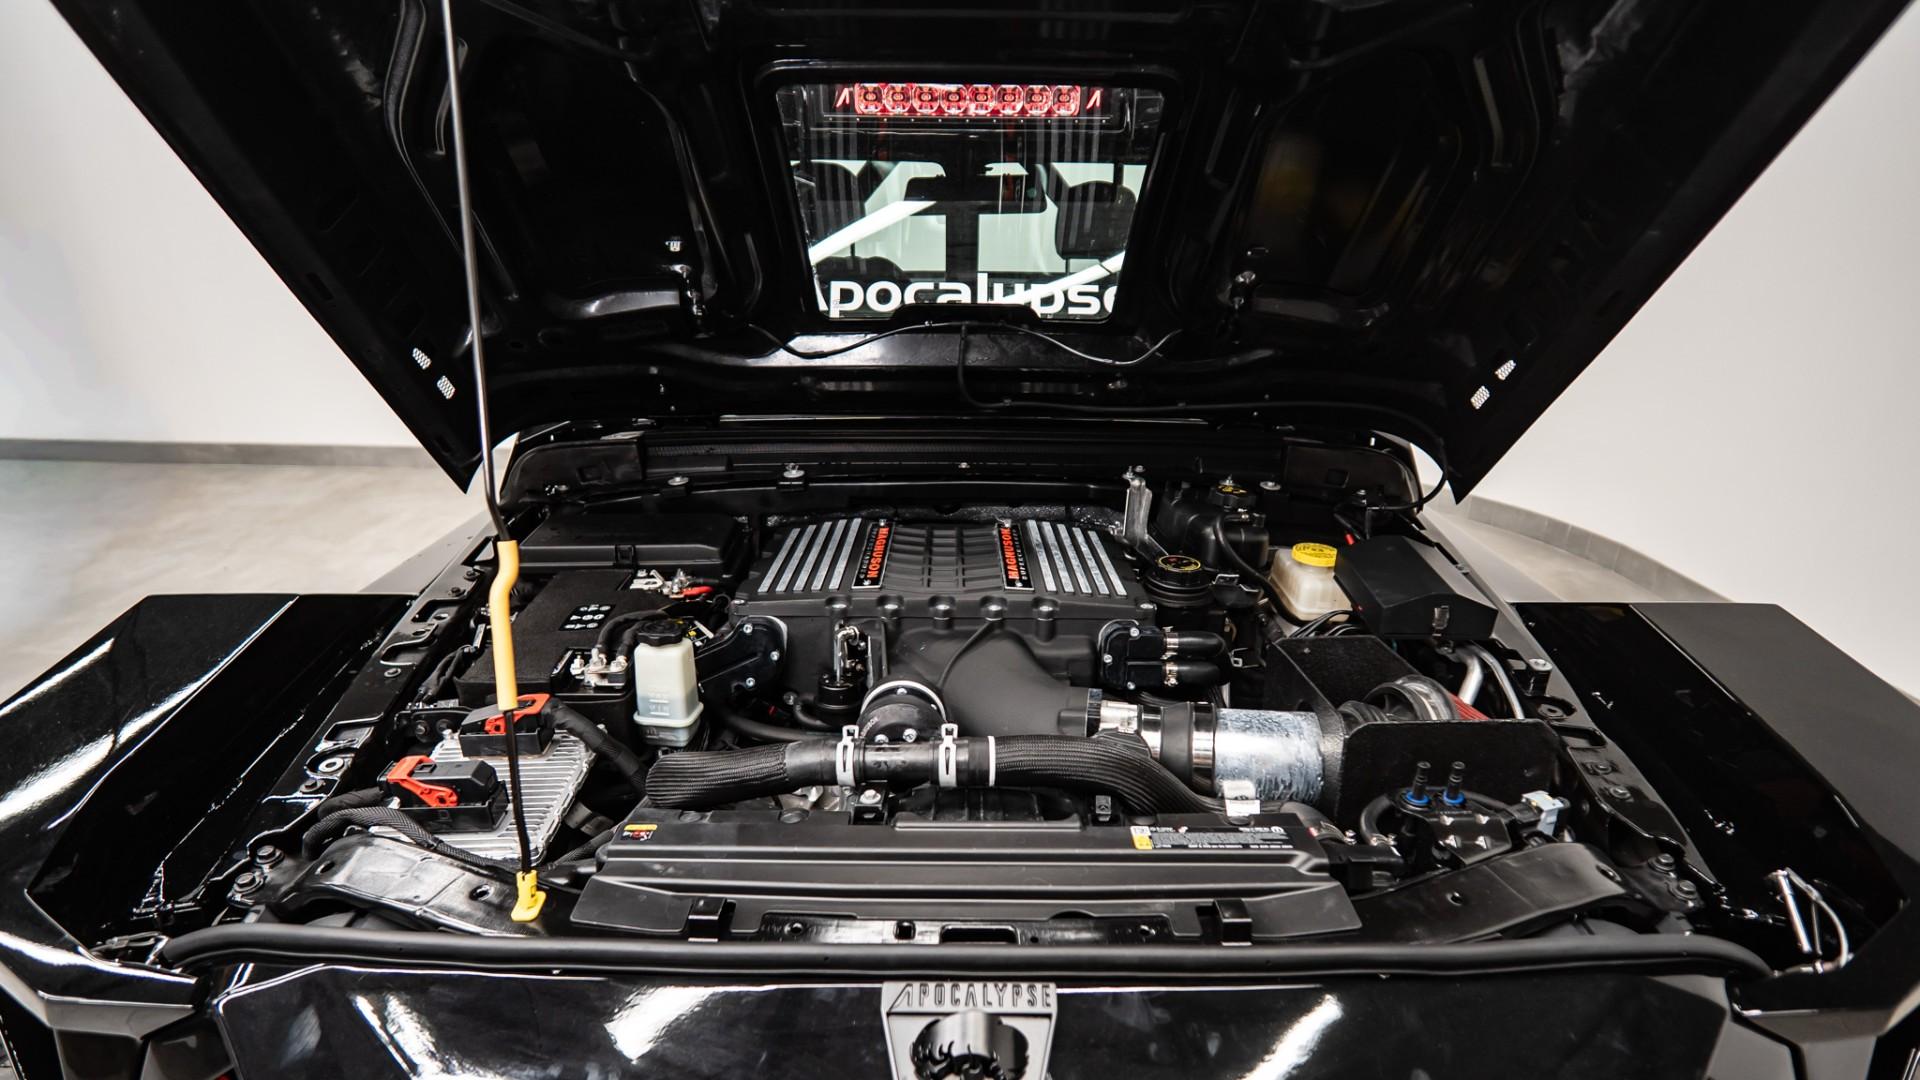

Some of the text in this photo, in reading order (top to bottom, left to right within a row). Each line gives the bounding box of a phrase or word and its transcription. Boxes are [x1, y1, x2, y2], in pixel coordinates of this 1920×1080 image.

[866, 527, 890, 578] MAGNUSON
[1000, 527, 1020, 579] MAGNUSON
[888, 983, 1052, 1011] APOCALYPSE
